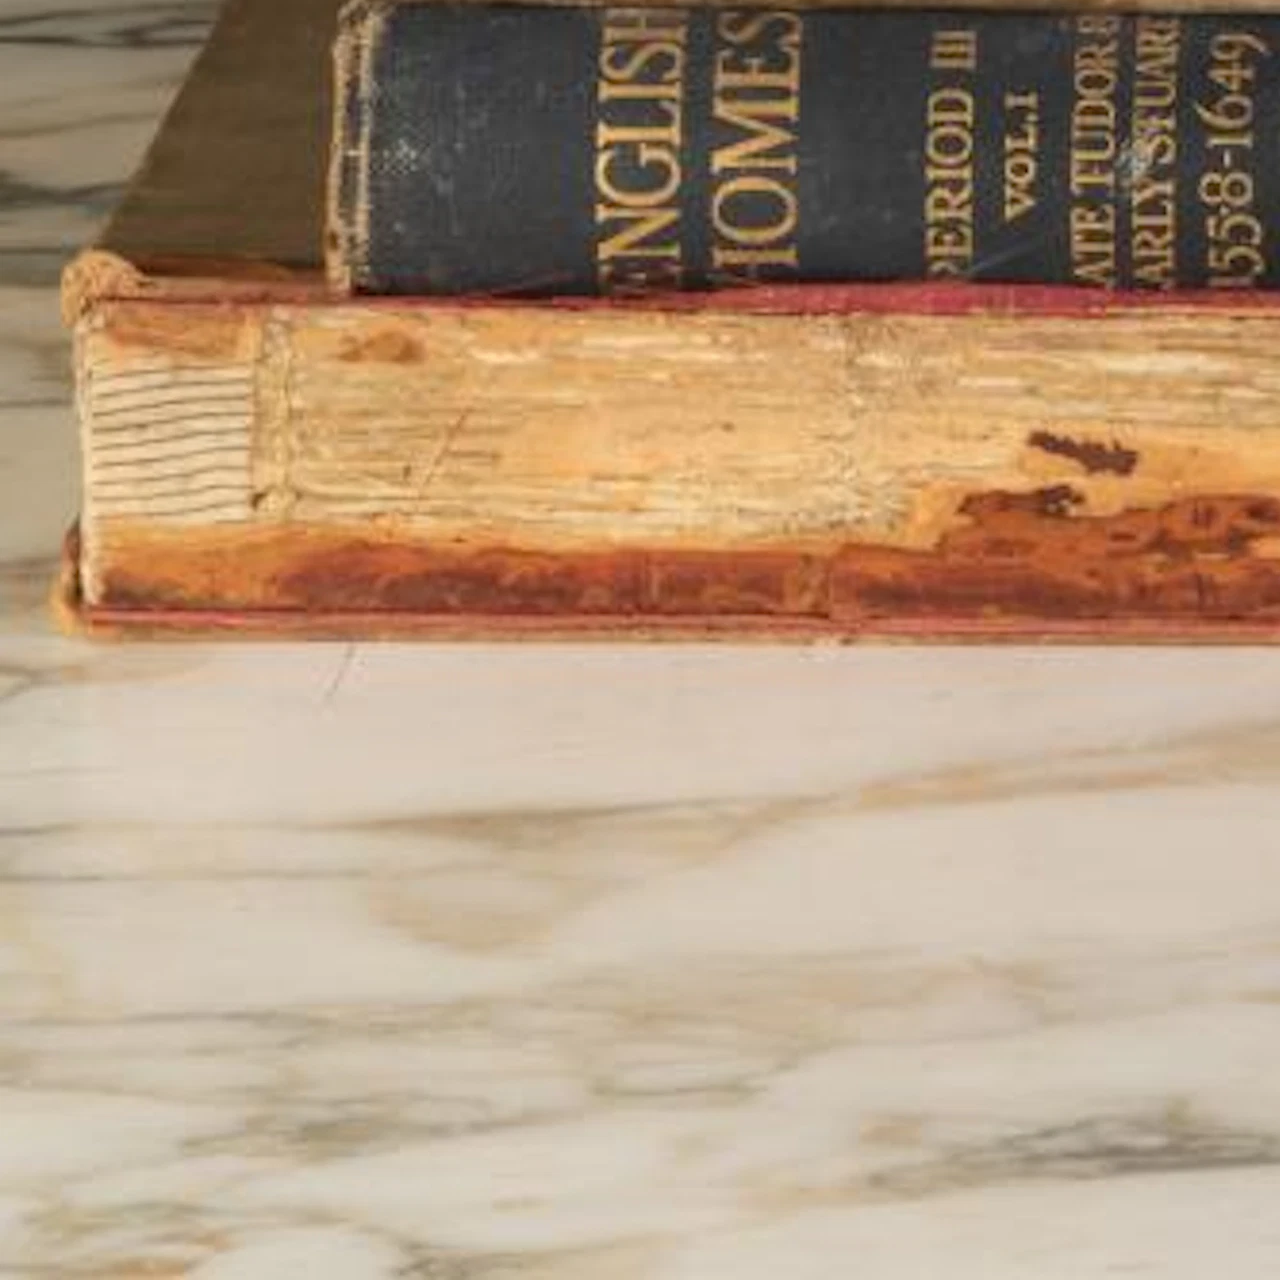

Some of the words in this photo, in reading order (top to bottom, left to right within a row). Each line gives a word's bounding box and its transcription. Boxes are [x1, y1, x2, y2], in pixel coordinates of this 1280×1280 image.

[930, 30, 977, 70] III
[1069, 43, 1119, 196] TUDOR
[1070, 203, 1117, 286] ATE
[1130, 173, 1176, 288] ARLY
